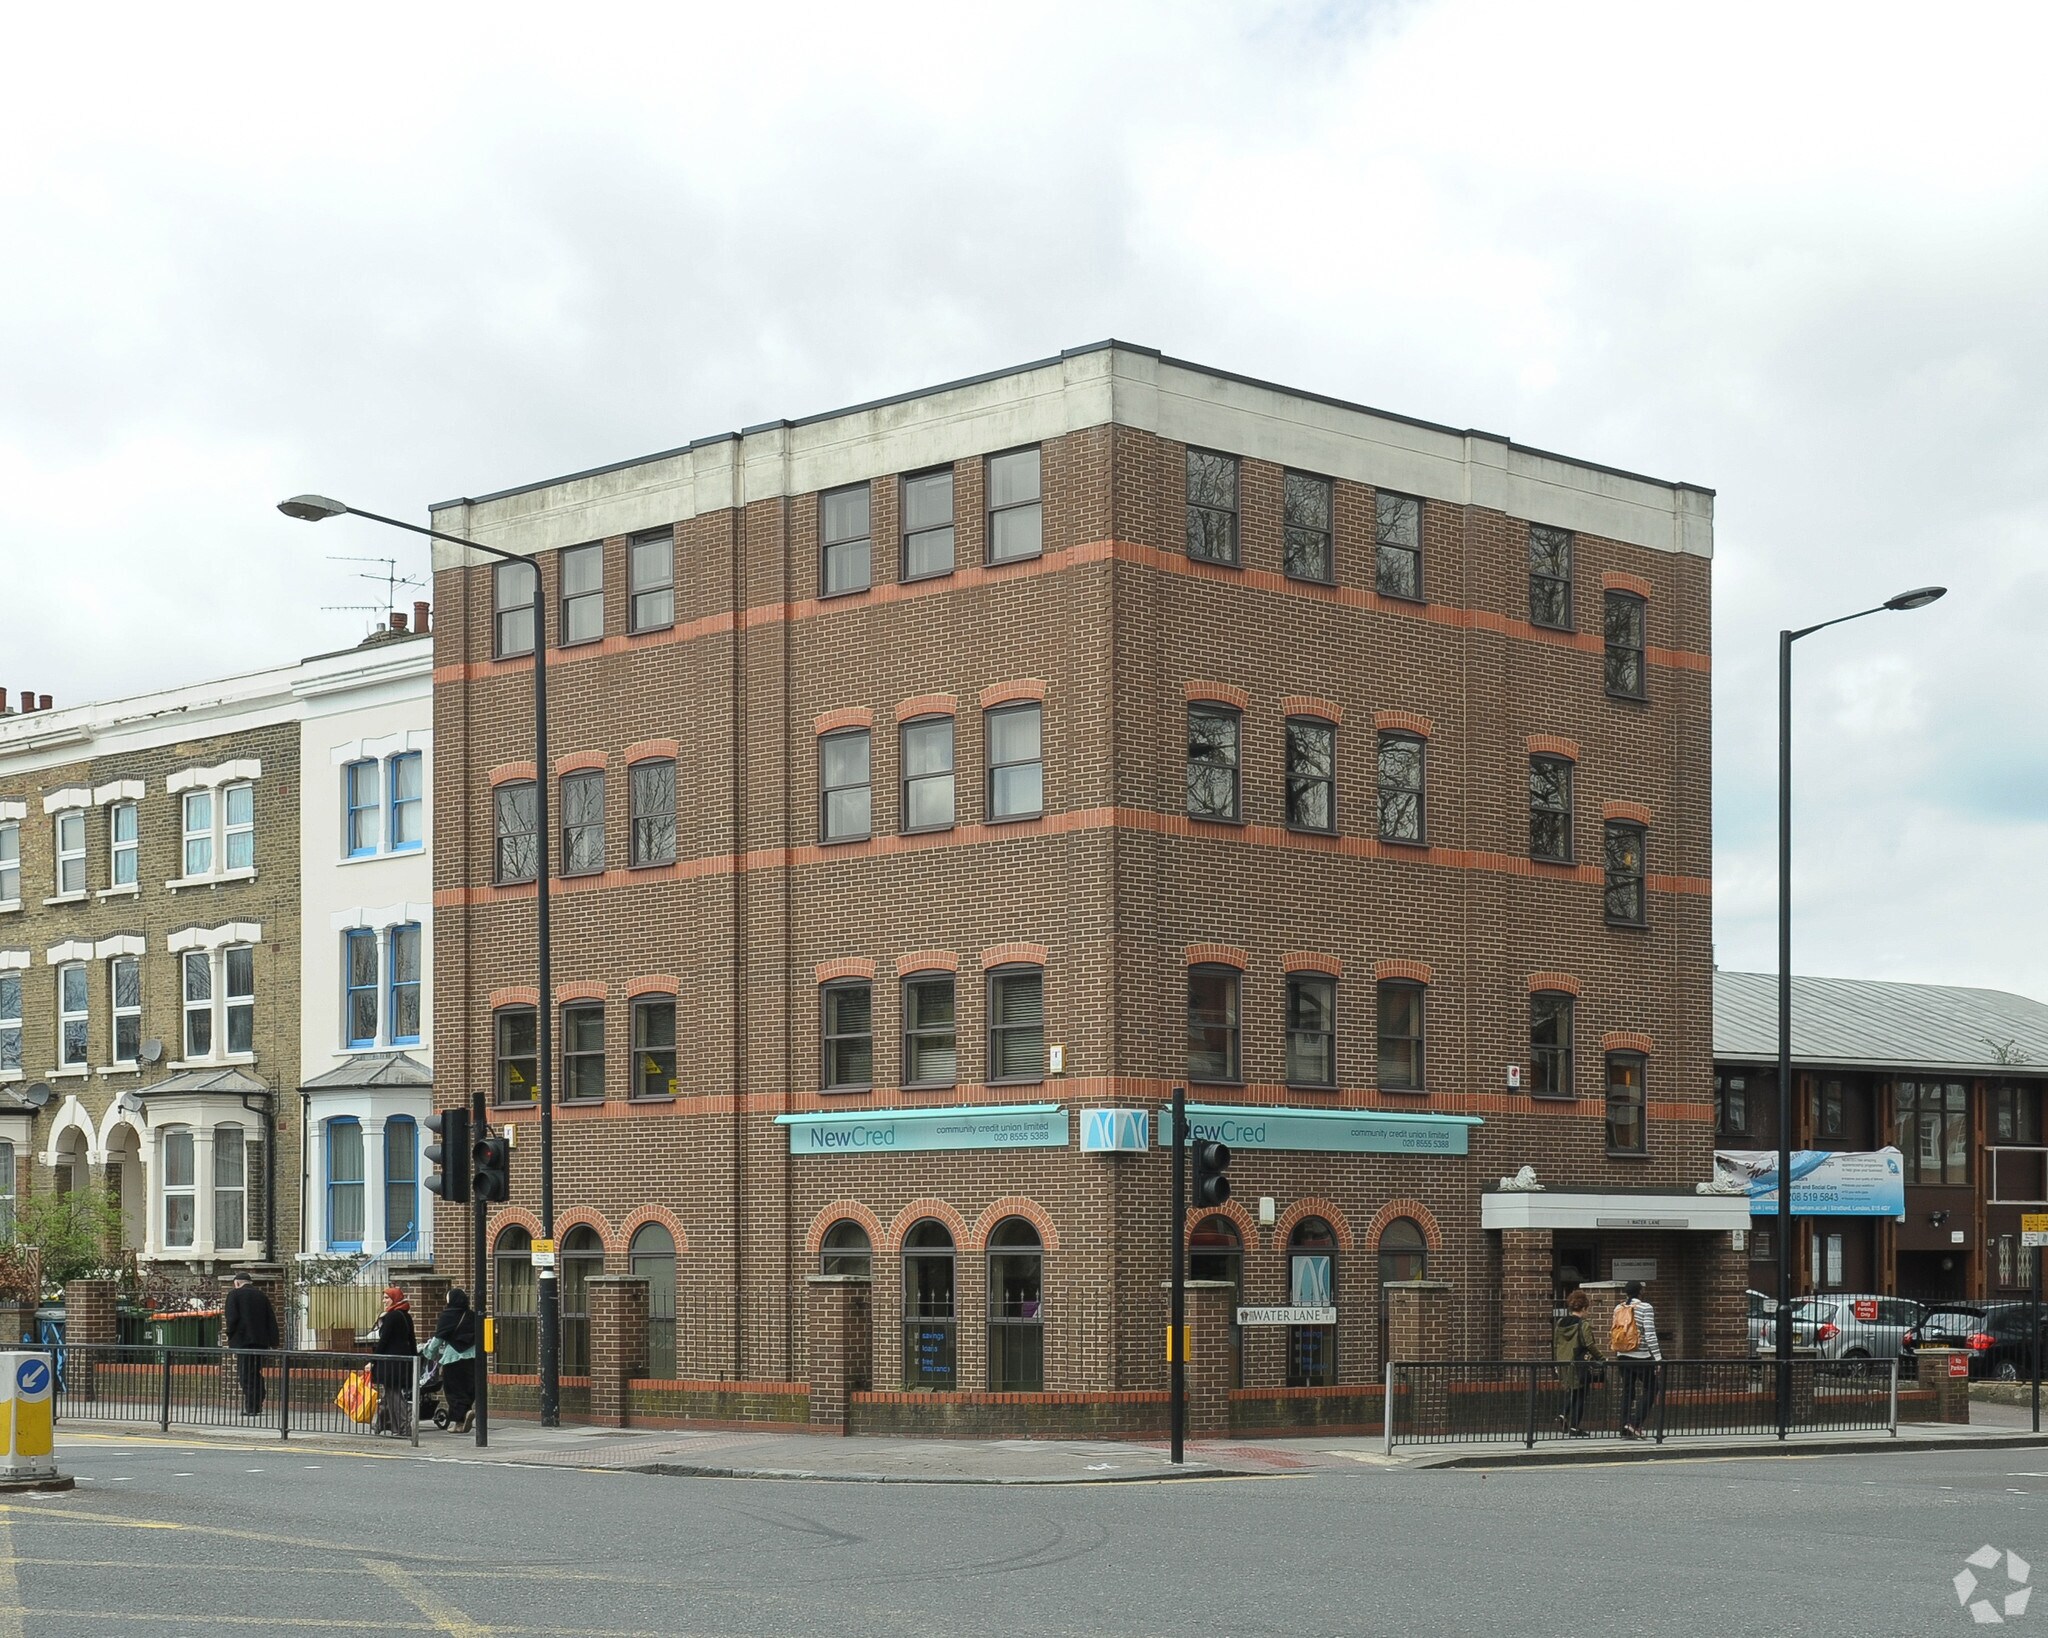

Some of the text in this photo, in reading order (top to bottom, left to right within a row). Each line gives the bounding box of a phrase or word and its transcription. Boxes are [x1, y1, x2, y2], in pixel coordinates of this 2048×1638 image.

[936, 1121, 1049, 1134] community credit union limited
[811, 1125, 895, 1147] NewCred
[993, 1131, 1049, 1141] 020 8555 5388
[1350, 1129, 1450, 1139] community credit union limited
[1402, 1139, 1450, 1149] 020 8555 5388
[1803, 1193, 1818, 1201] 519
[1819, 1193, 1839, 1202] 5843
[1253, 1310, 1290, 1321] WATER
[1293, 1310, 1321, 1321] LANE
